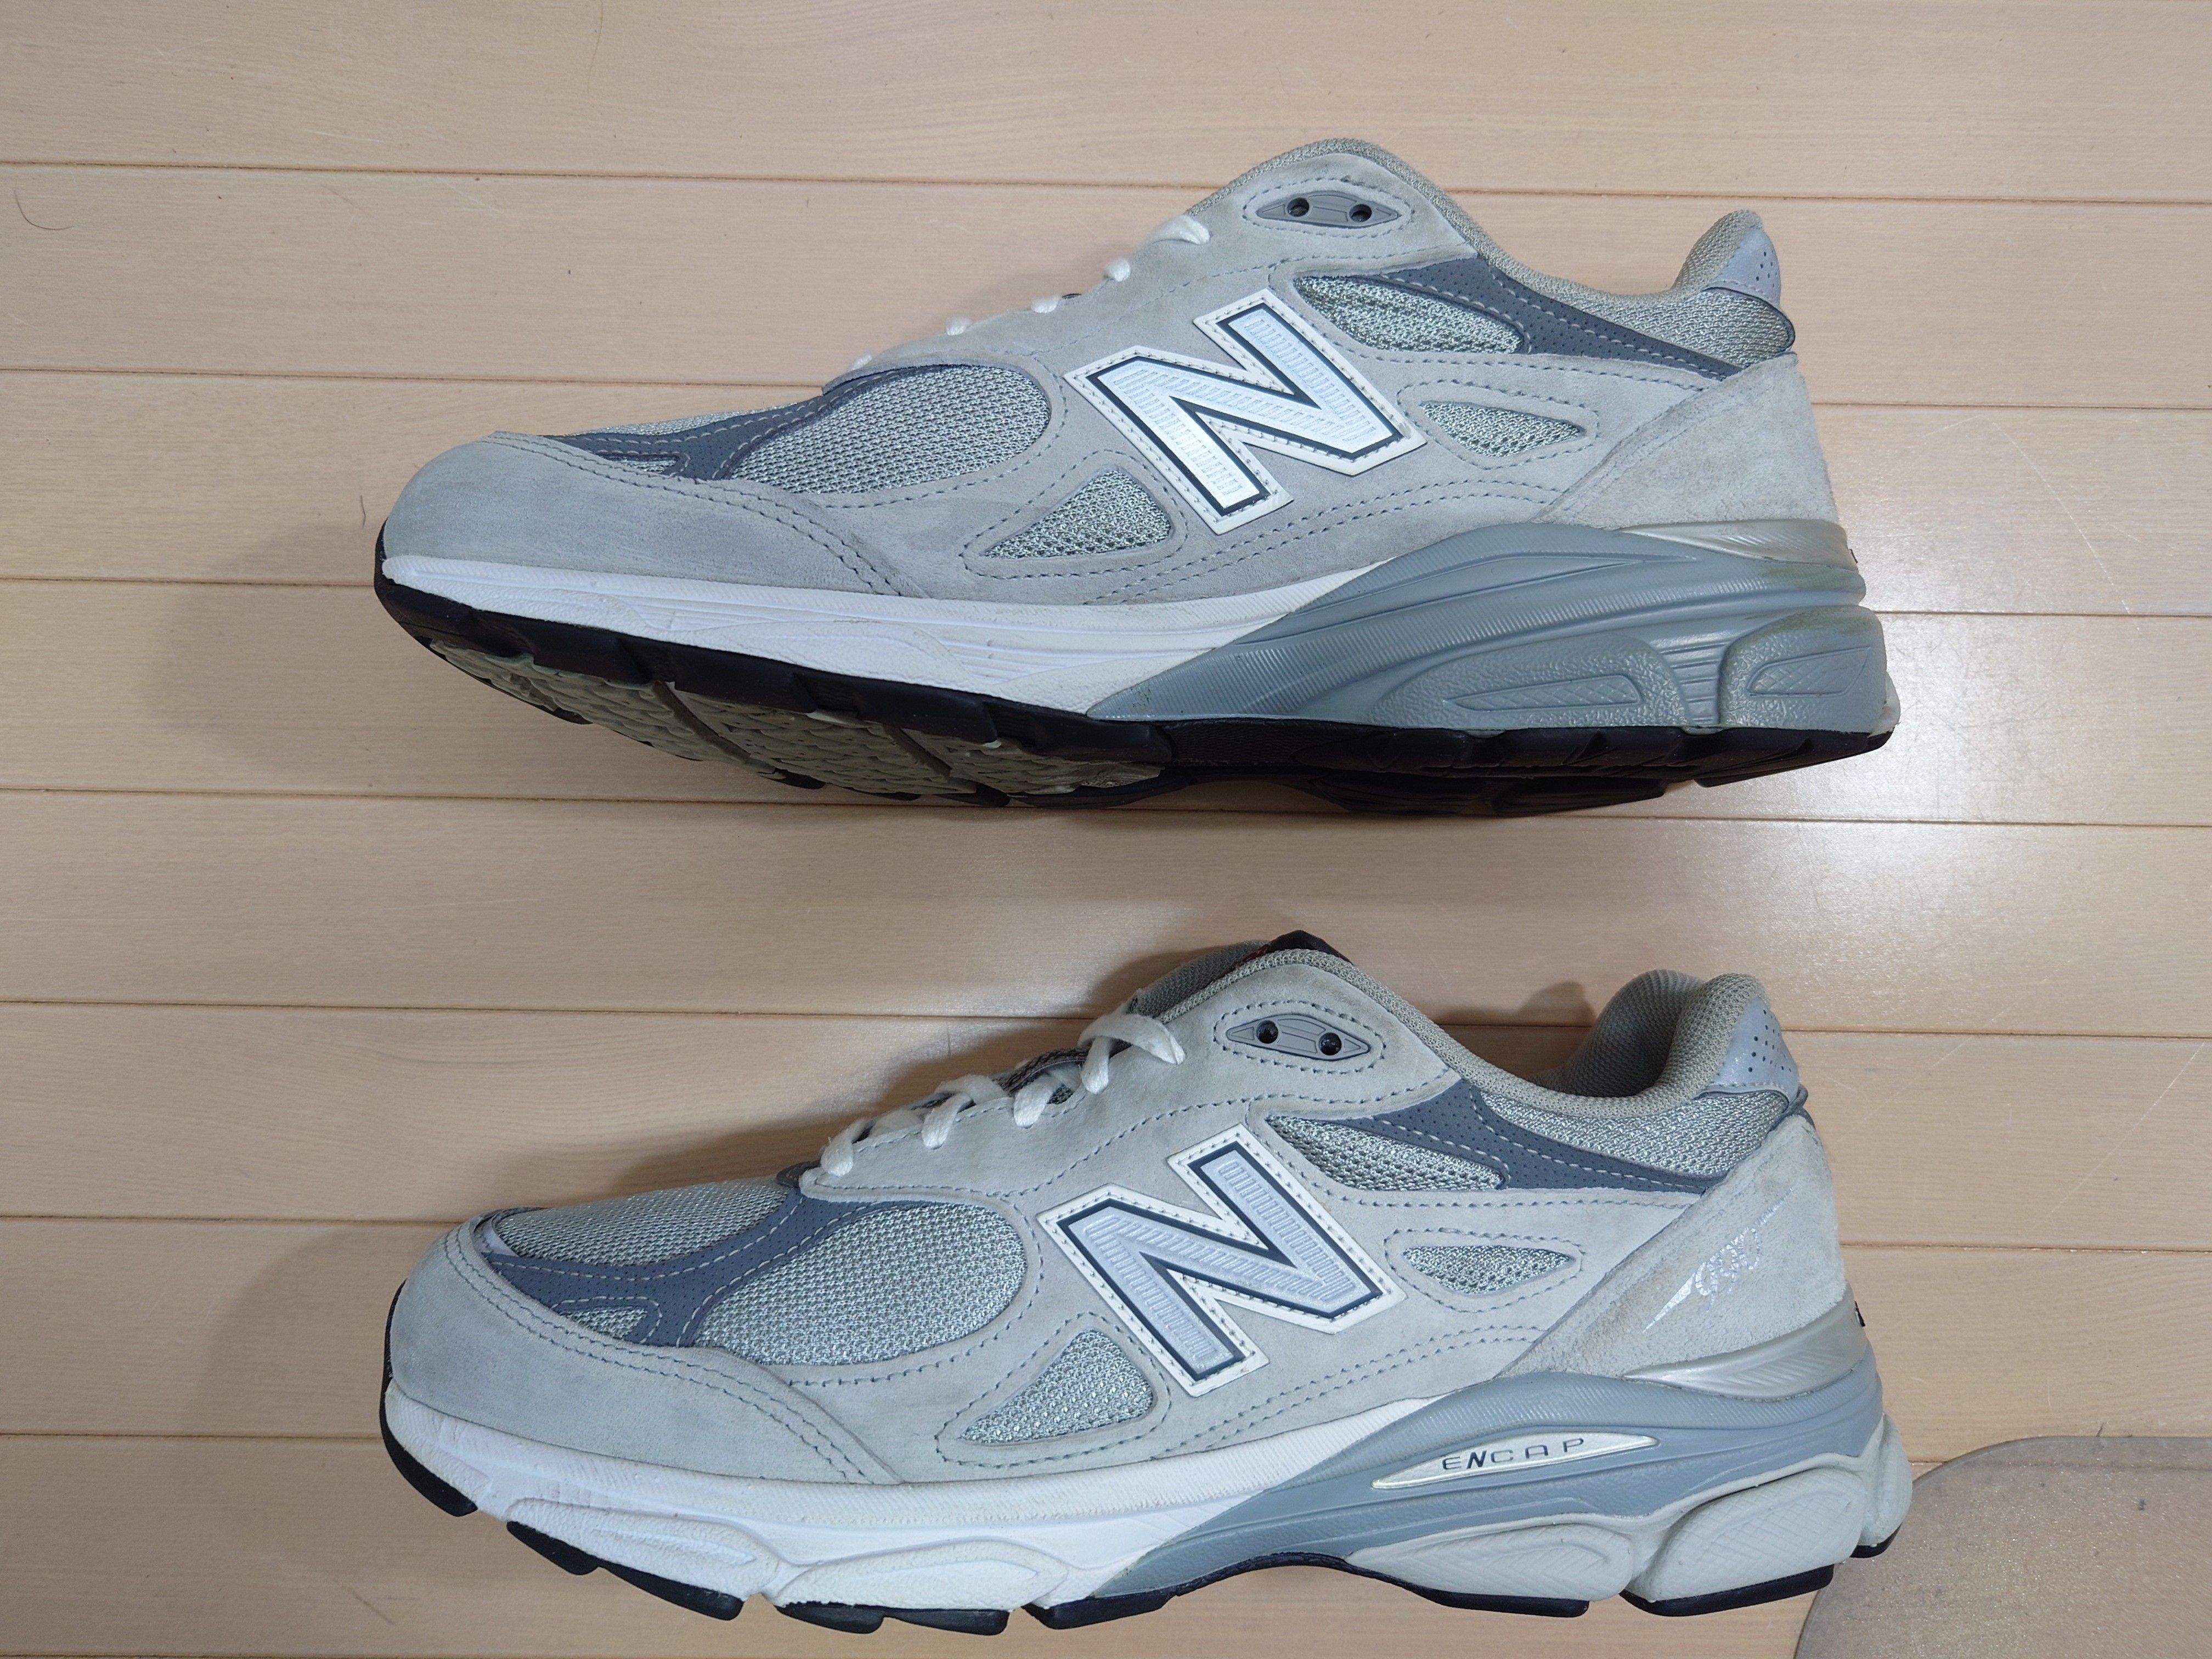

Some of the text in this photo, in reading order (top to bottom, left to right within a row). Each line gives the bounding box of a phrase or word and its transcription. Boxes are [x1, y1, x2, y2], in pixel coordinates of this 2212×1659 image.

[1064, 289, 1426, 534] N
[1037, 1124, 1407, 1396] N
[1442, 1437, 1584, 1470] ENCAP
